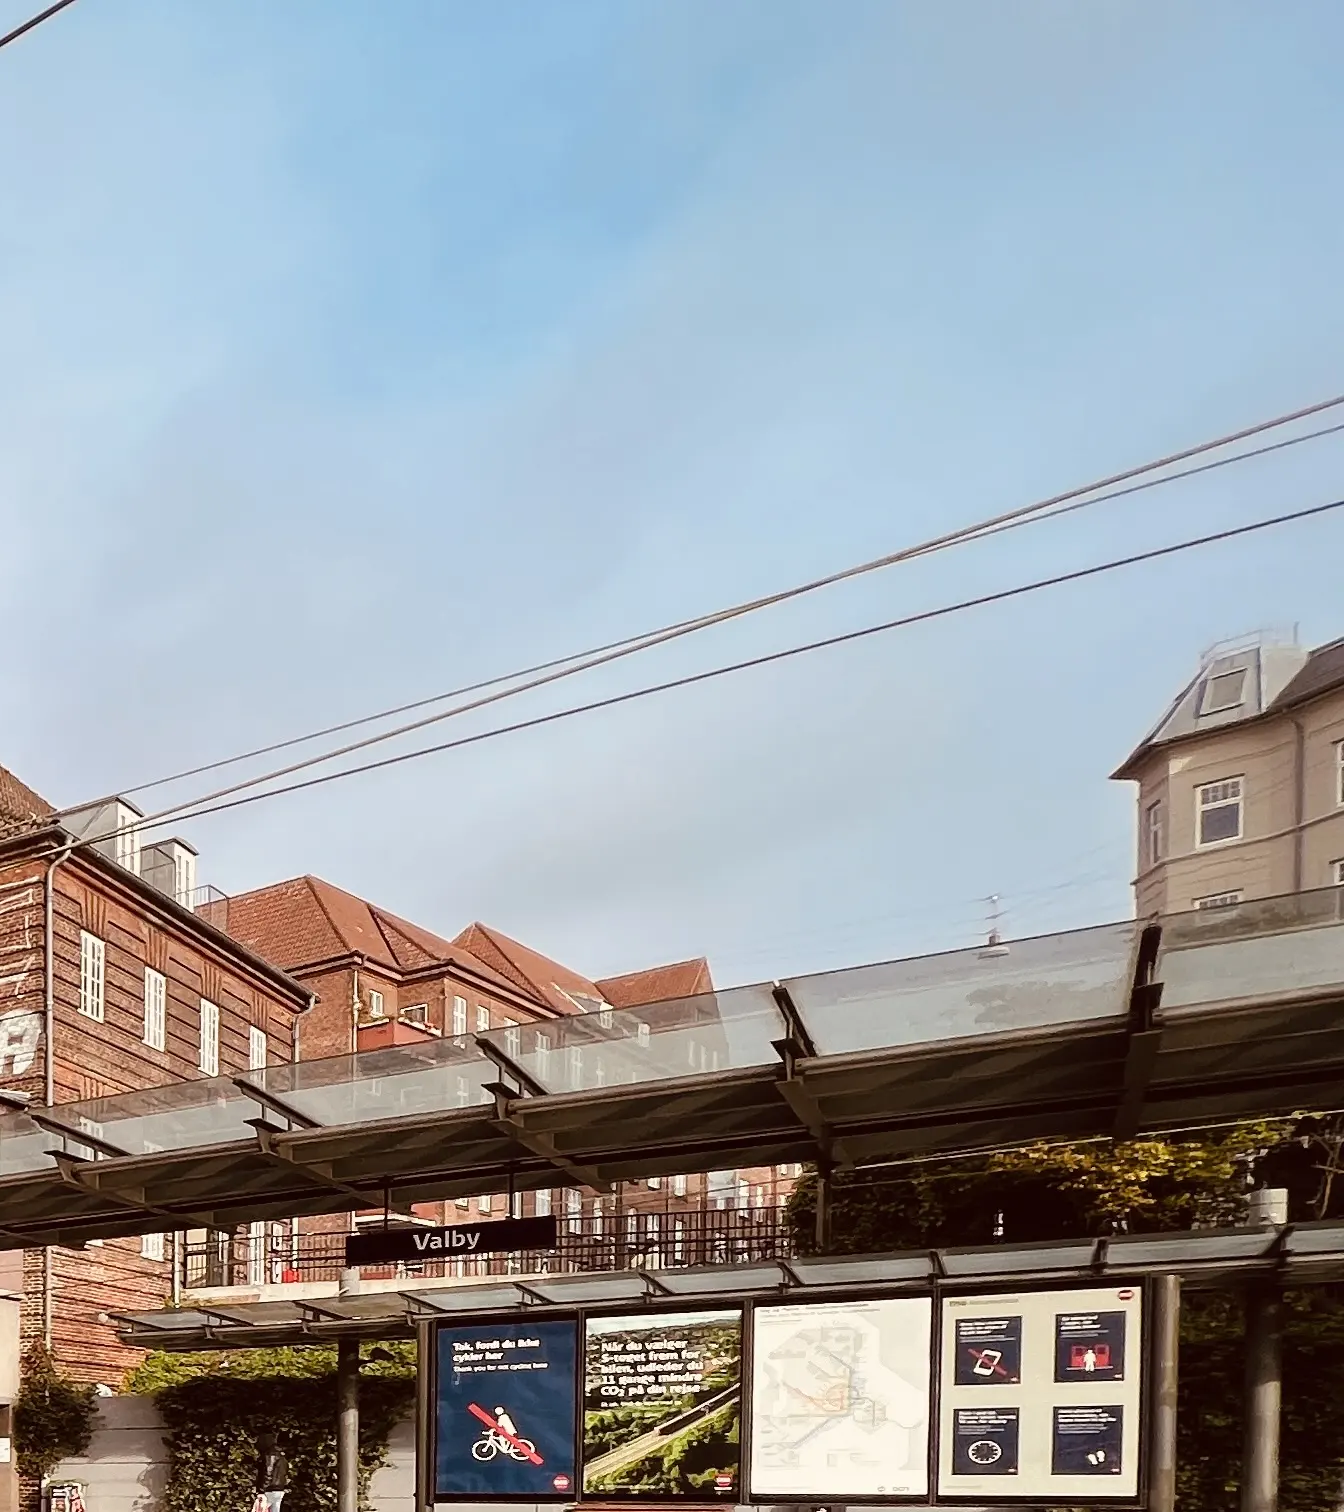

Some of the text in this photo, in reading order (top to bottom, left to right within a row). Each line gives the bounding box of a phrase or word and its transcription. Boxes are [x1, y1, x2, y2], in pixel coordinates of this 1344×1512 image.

[413, 1230, 481, 1251] Valby
[601, 1340, 624, 1352] Når
[625, 1340, 643, 1351] du
[648, 1350, 679, 1361] frem
[680, 1349, 700, 1360] for
[686, 1360, 704, 1371] du
[627, 1383, 645, 1397] på
[646, 1382, 667, 1395] din
